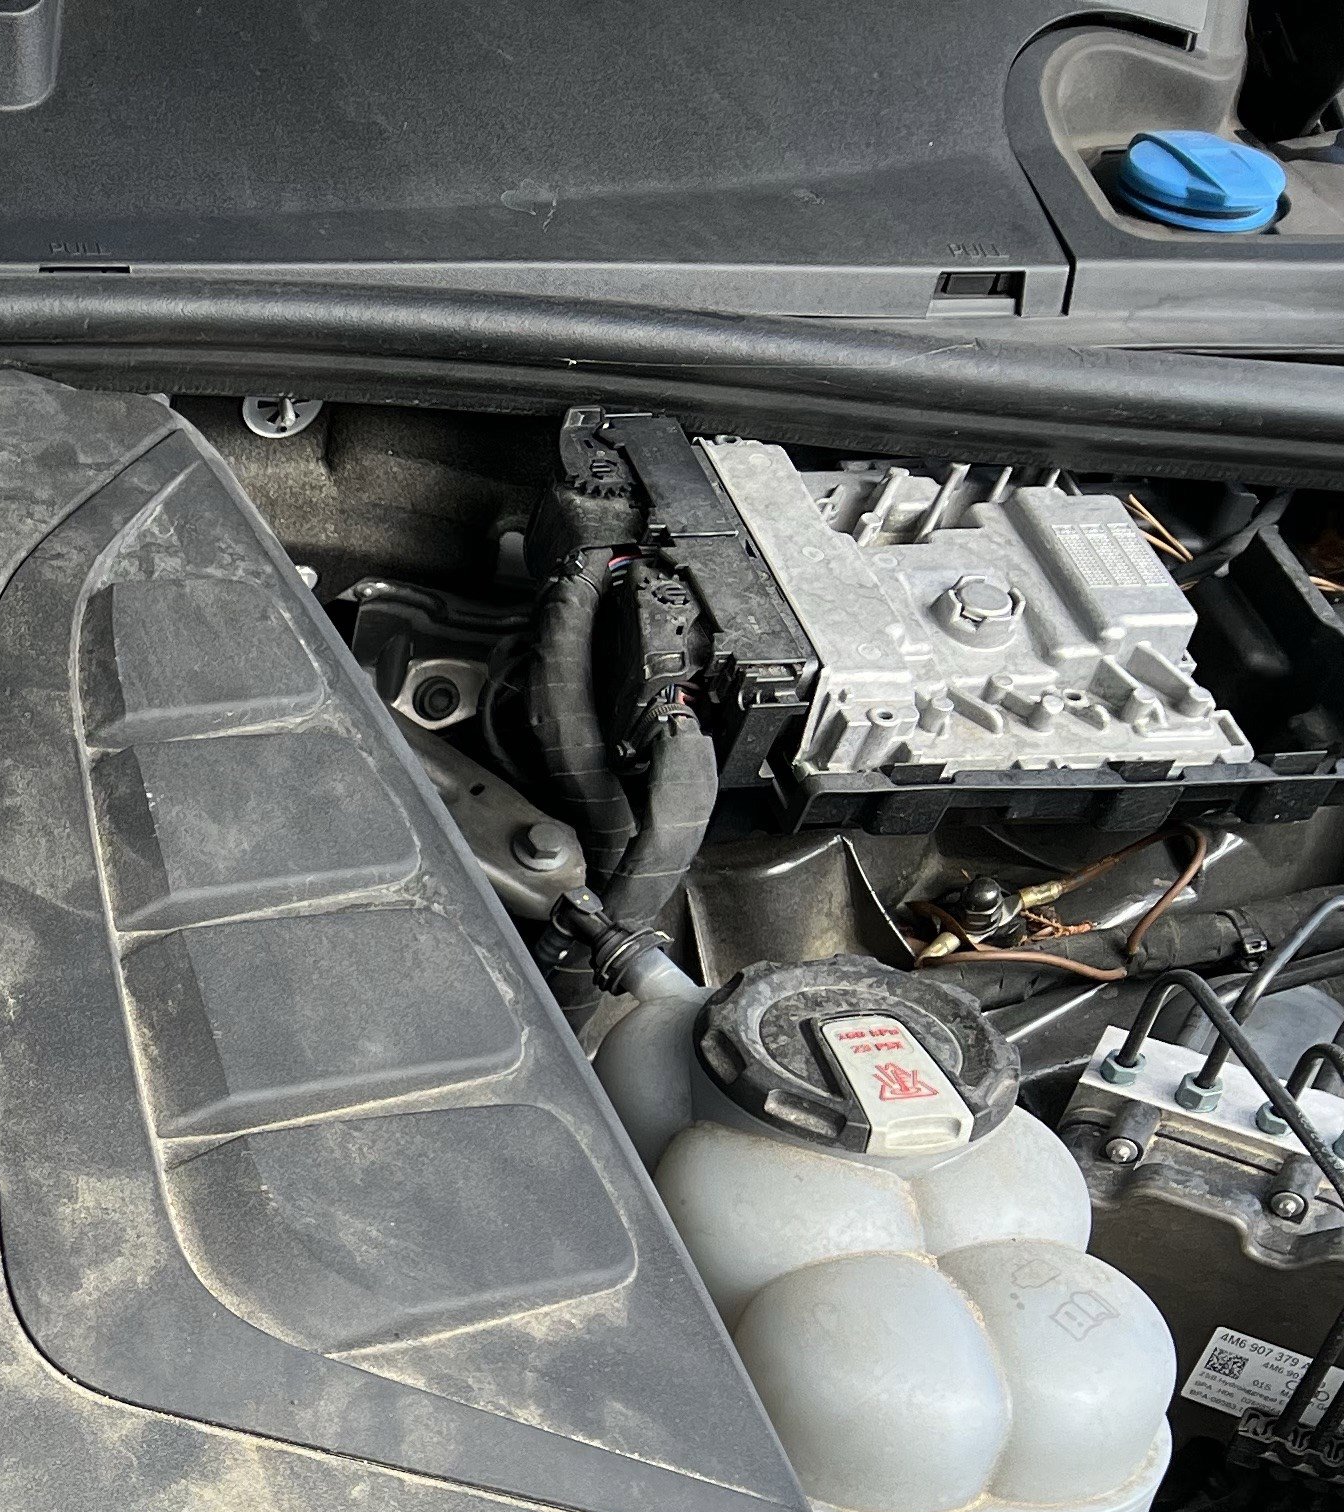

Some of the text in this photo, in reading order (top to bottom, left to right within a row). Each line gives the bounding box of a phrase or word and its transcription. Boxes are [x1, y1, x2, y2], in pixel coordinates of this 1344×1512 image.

[49, 241, 111, 256] PULL
[946, 243, 1009, 258] PULL
[1220, 1332, 1247, 1349] 4M6
[1249, 1342, 1274, 1357] 907
[1274, 1351, 1300, 1367] 379
[1262, 1361, 1284, 1374] 4M6
